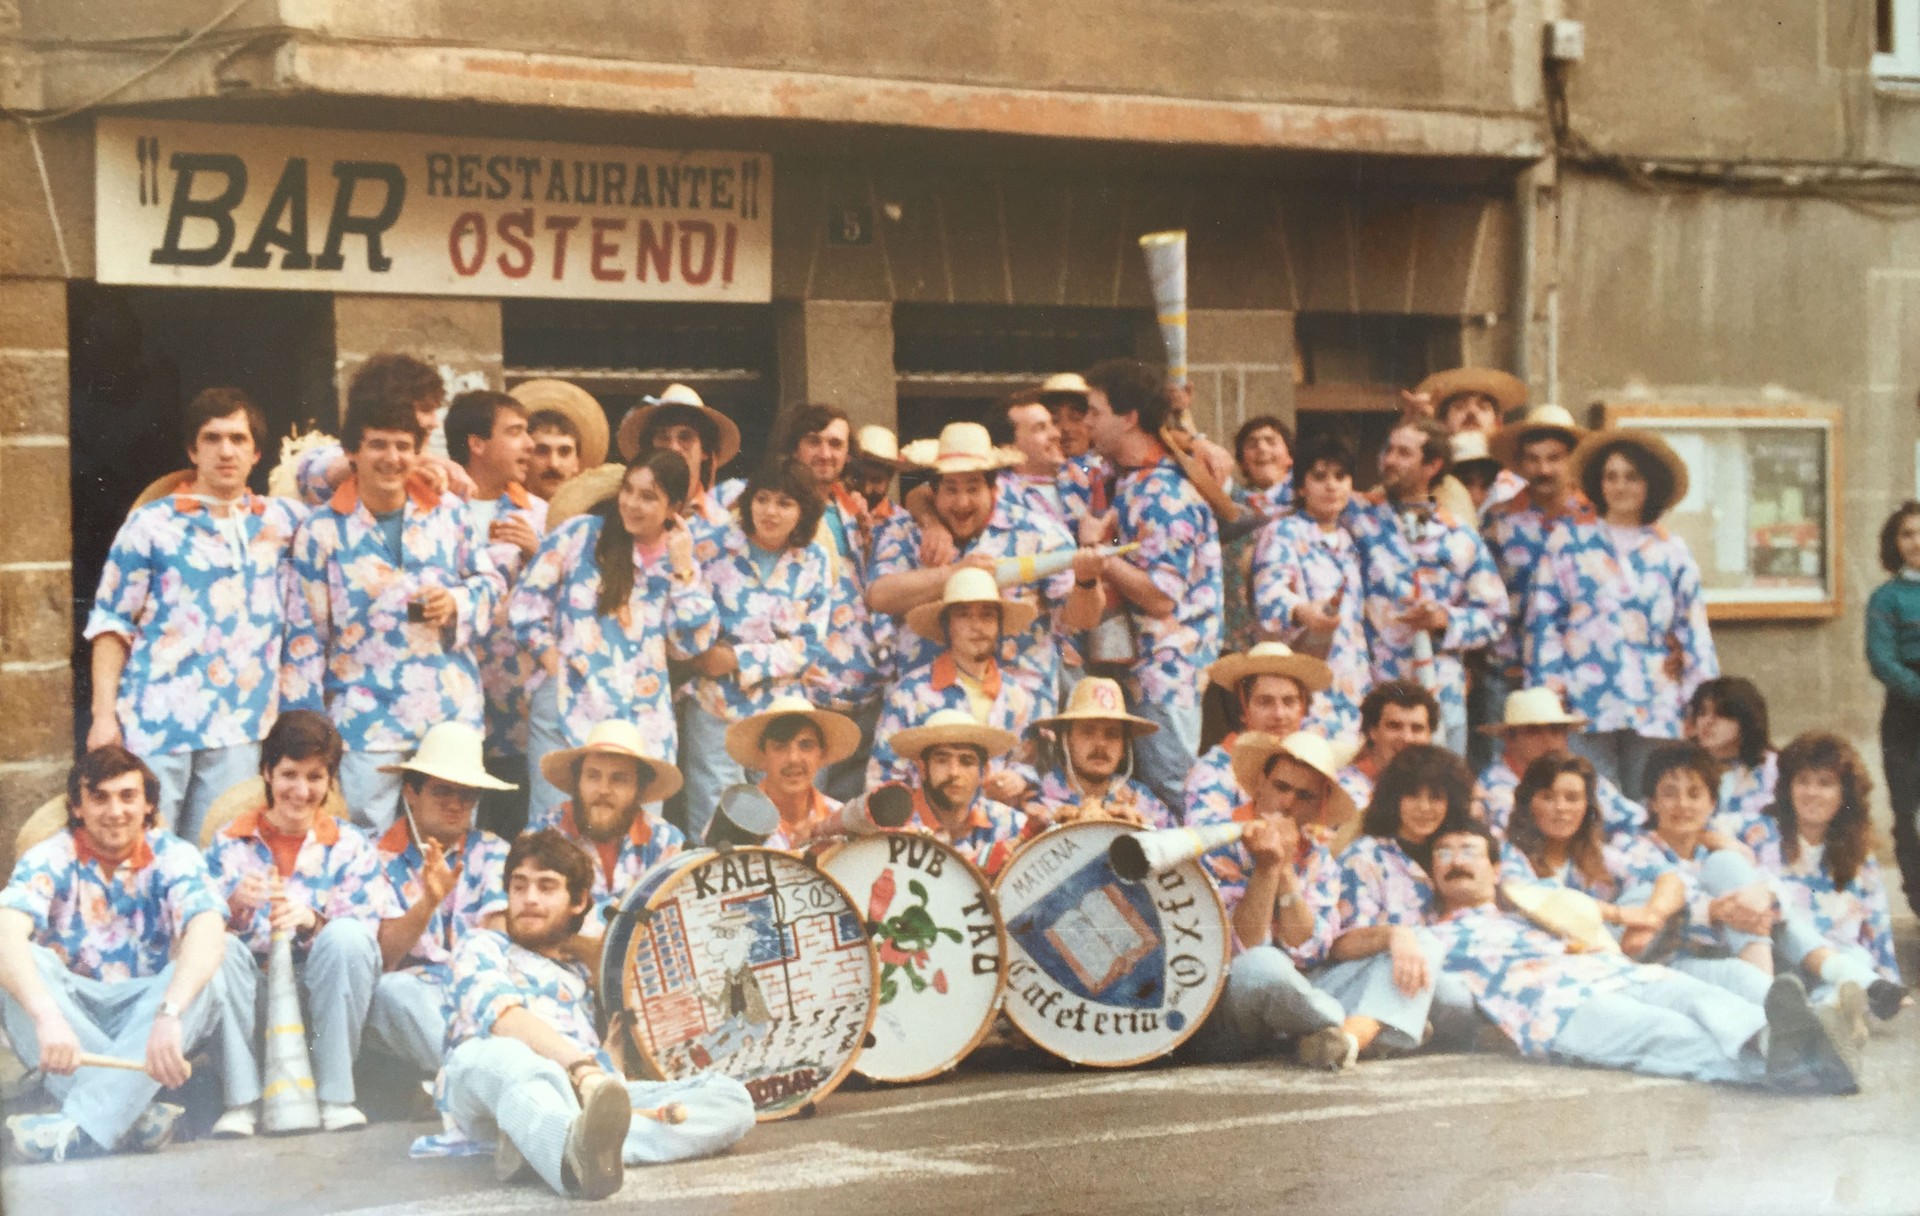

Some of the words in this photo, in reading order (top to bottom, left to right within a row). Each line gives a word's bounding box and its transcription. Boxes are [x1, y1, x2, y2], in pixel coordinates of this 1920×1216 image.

[150, 152, 406, 274] BAR
[426, 153, 738, 211] RESTAURANTE
[448, 208, 738, 286] OSTENDI
[888, 835, 948, 878] PUB
